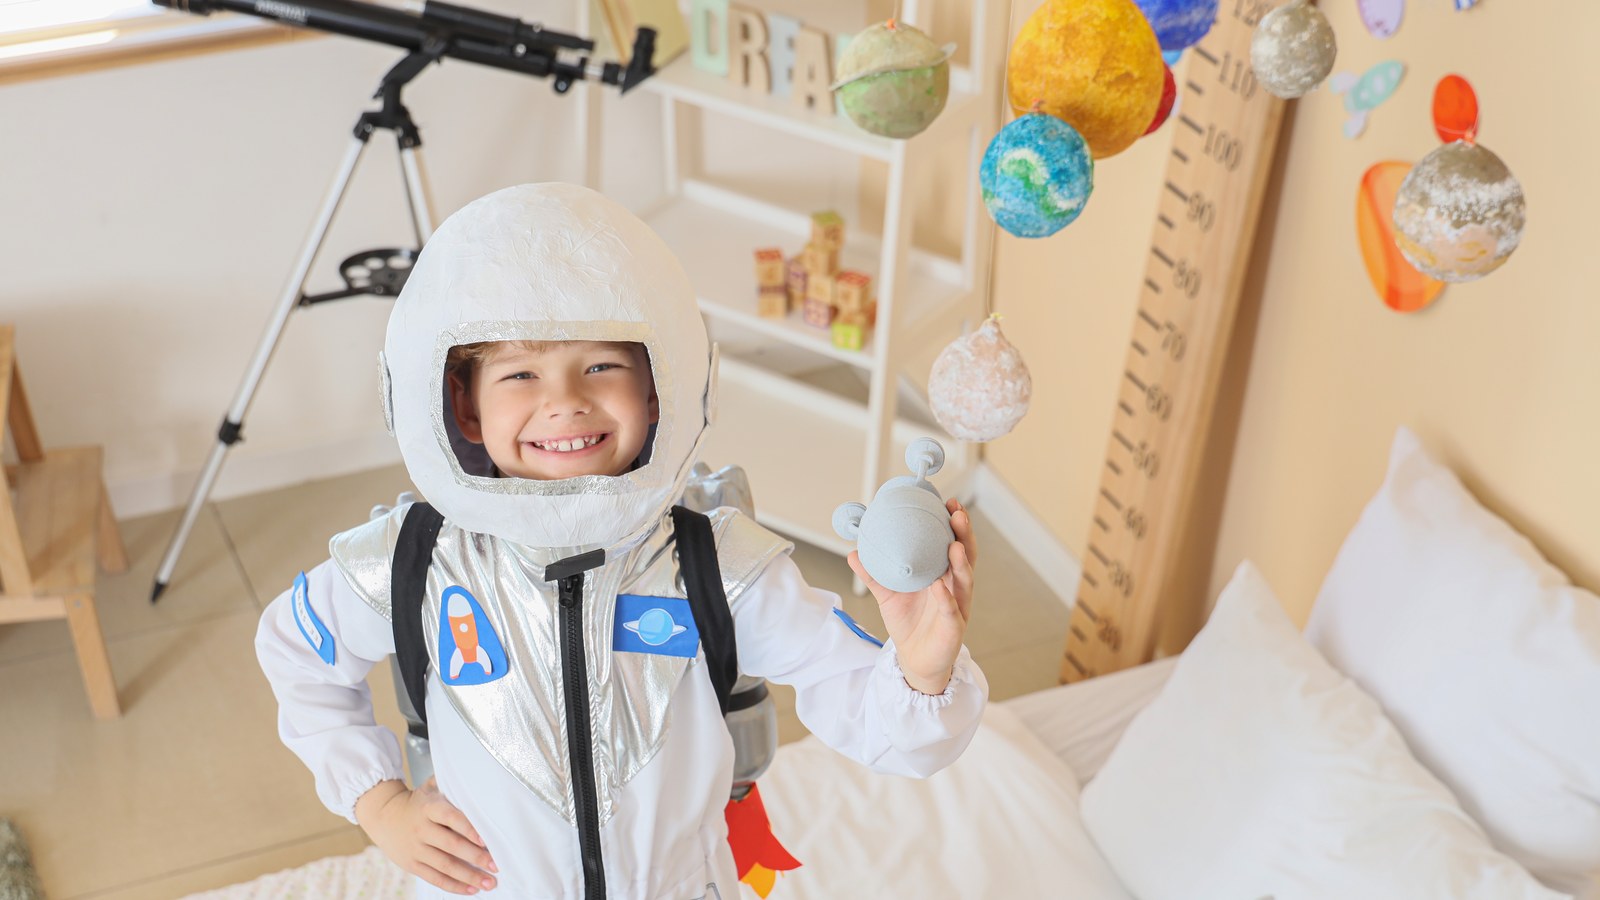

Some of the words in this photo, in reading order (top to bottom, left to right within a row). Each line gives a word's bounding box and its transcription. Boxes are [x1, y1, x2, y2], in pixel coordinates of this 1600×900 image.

[690, 0, 848, 118] DREA
[1217, 52, 1257, 101] 110
[1203, 123, 1243, 172] 100
[1187, 190, 1216, 233] 90
[1173, 256, 1202, 299] 80
[1161, 320, 1187, 363] 70
[1146, 383, 1173, 423] 60
[1133, 440, 1160, 480] 50
